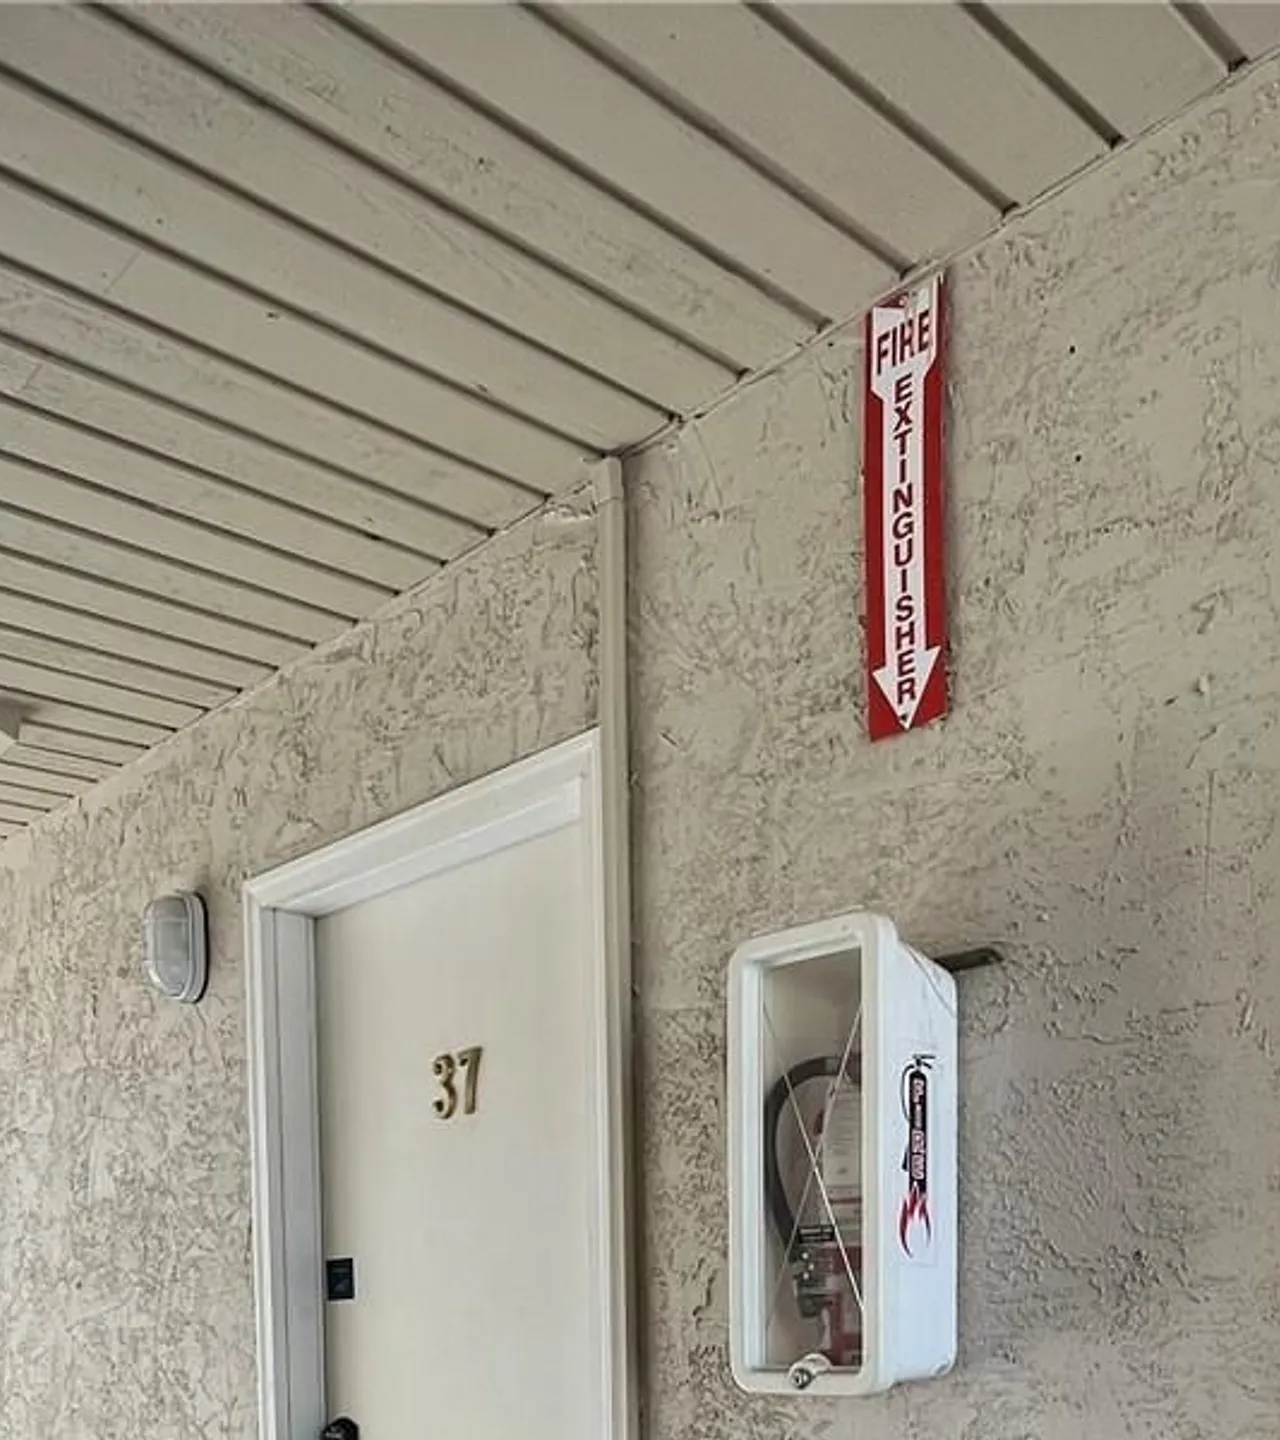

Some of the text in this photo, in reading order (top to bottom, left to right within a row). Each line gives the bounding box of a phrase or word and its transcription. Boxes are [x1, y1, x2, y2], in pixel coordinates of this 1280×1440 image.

[877, 309, 930, 376] FIRE
[892, 373, 917, 705] EXTINGUISHER
[431, 1045, 483, 1121] 37
